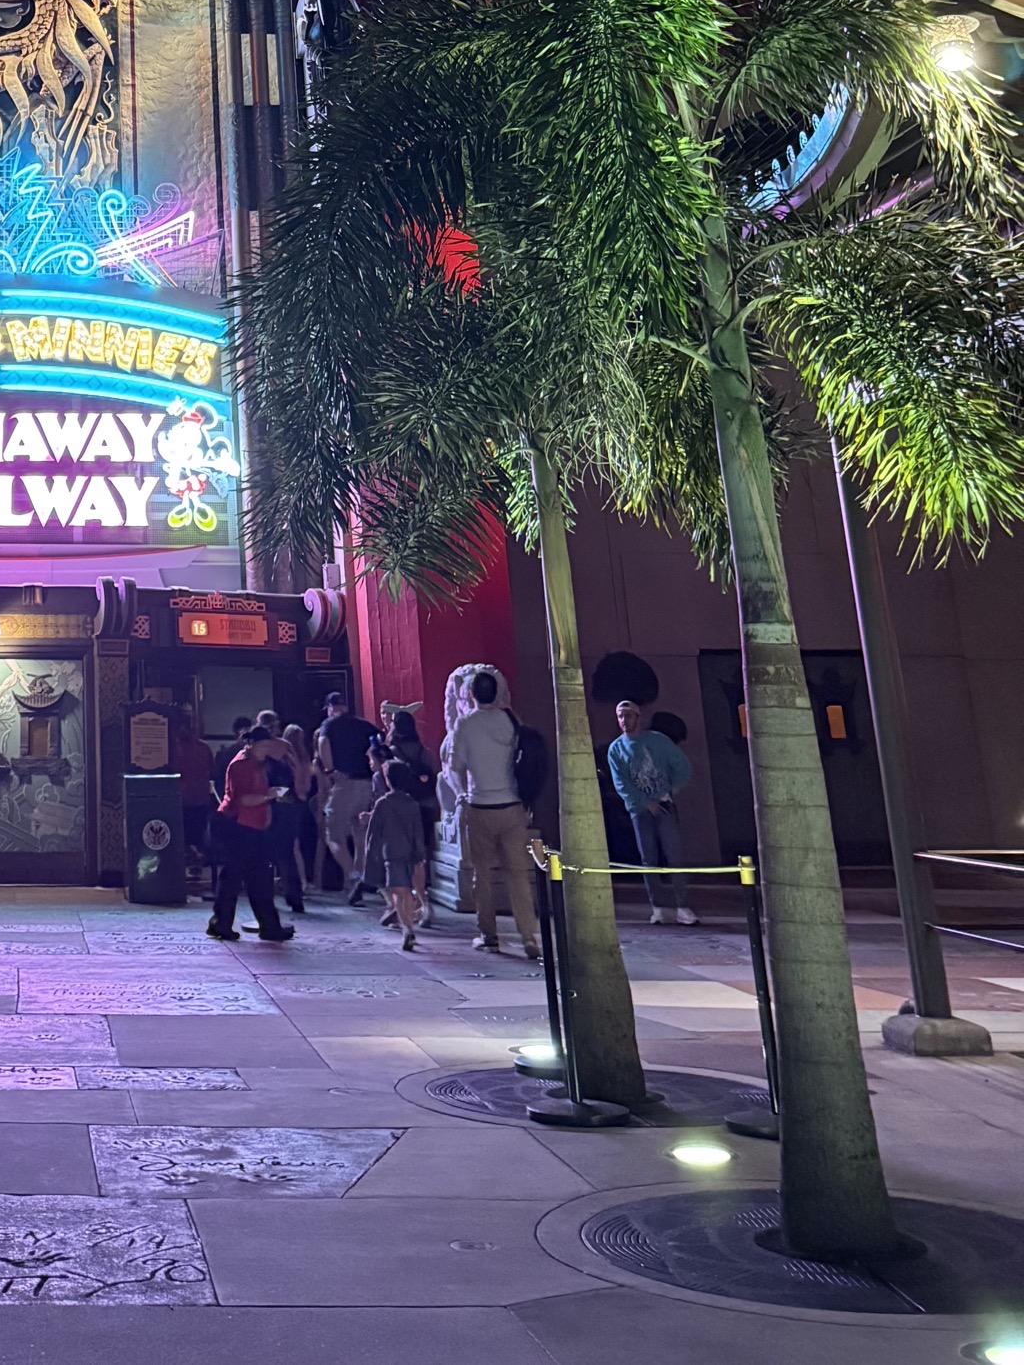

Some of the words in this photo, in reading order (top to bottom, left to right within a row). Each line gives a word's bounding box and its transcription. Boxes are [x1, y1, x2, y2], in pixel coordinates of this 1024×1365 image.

[5, 315, 217, 385] MINNIE'S
[192, 622, 206, 635] 15
[219, 618, 256, 632] STANDBY
